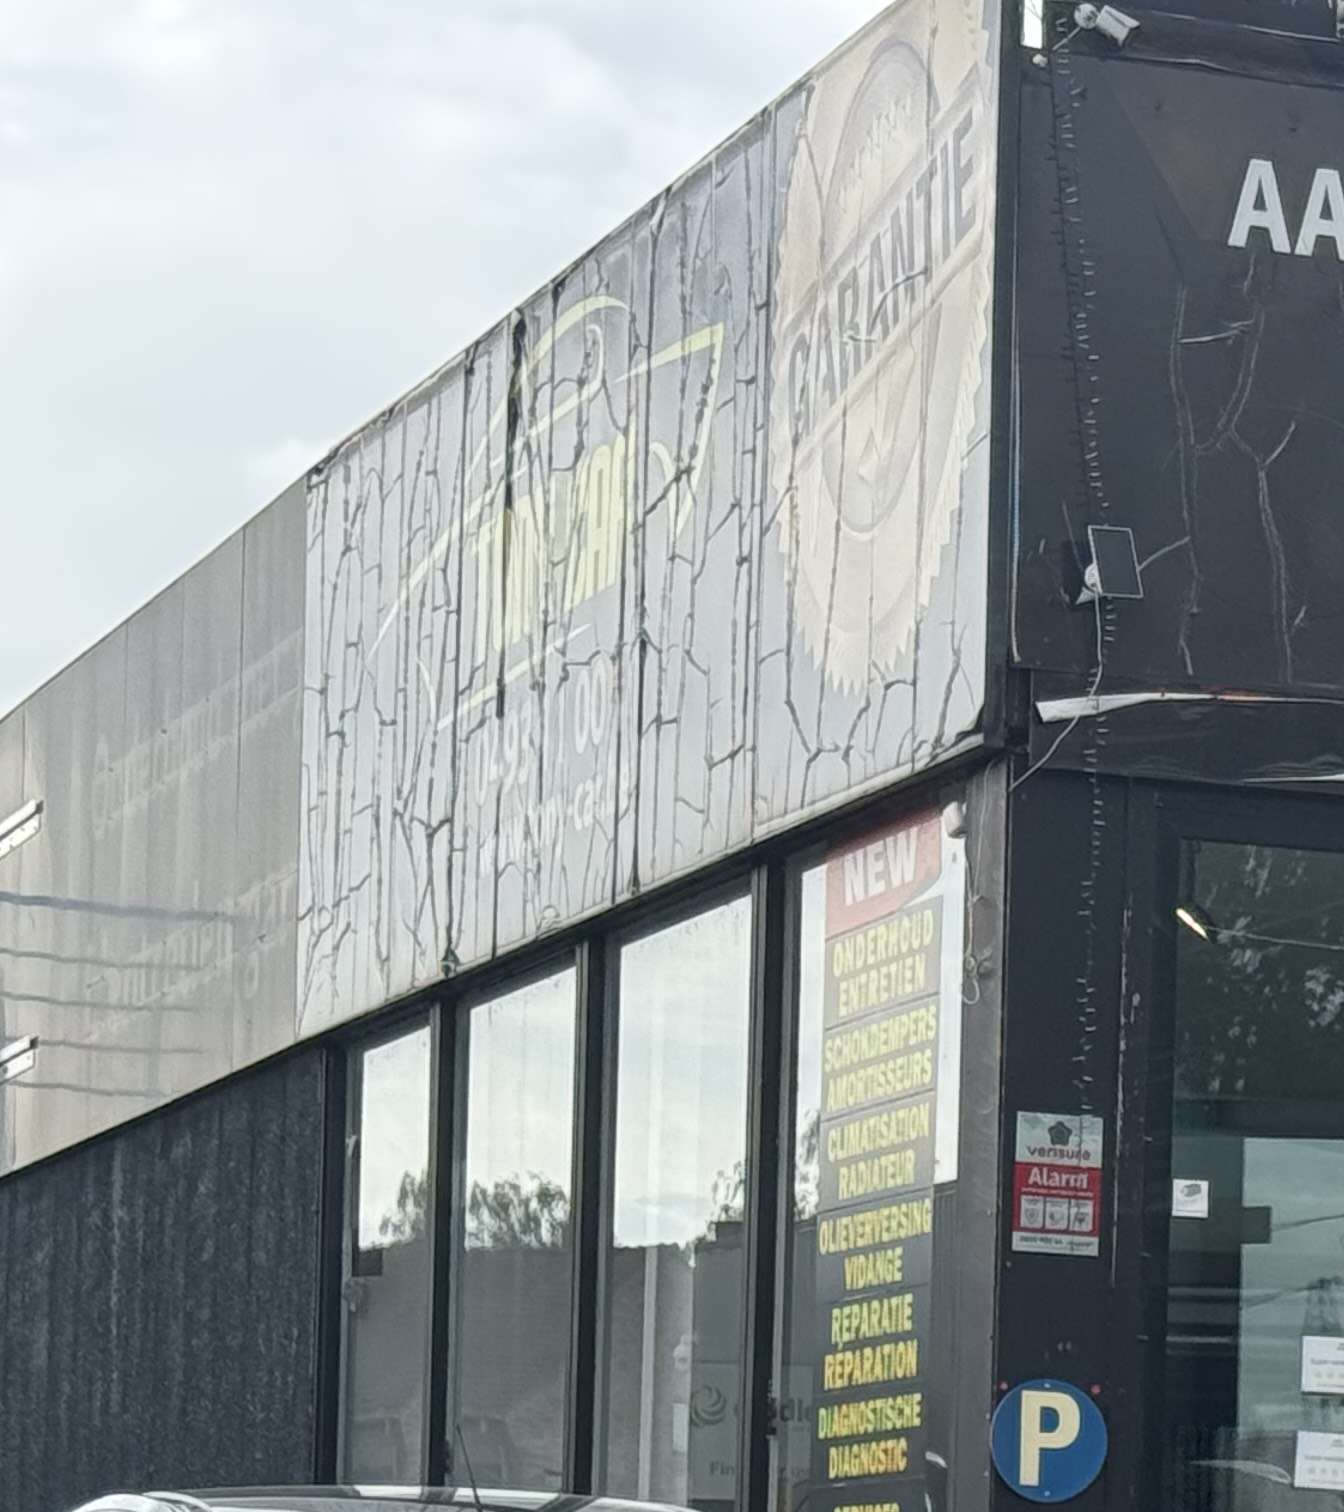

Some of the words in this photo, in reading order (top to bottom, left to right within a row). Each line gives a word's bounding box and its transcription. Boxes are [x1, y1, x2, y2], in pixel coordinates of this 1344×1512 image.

[788, 107, 976, 437] GARANTIE
[843, 825, 919, 907] NEW
[832, 909, 935, 977] ONDERHOUD
[838, 953, 926, 1018] ENTRETIEN
[826, 1049, 932, 1113] AMORTISSEURS
[827, 1102, 930, 1163] CLIMATISATION
[838, 1149, 916, 1201] RADIATEUR
[819, 1198, 933, 1255] OLIEVERVERSING
[844, 1247, 903, 1291] VIDANGE
[831, 1292, 913, 1345] REPARATIE
[824, 1338, 918, 1391] REPARATION
[818, 1392, 922, 1440] DIAGNOSTISCHE
[1019, 1390, 1080, 1486] P
[828, 1437, 908, 1479] DIAGNOSTIC
